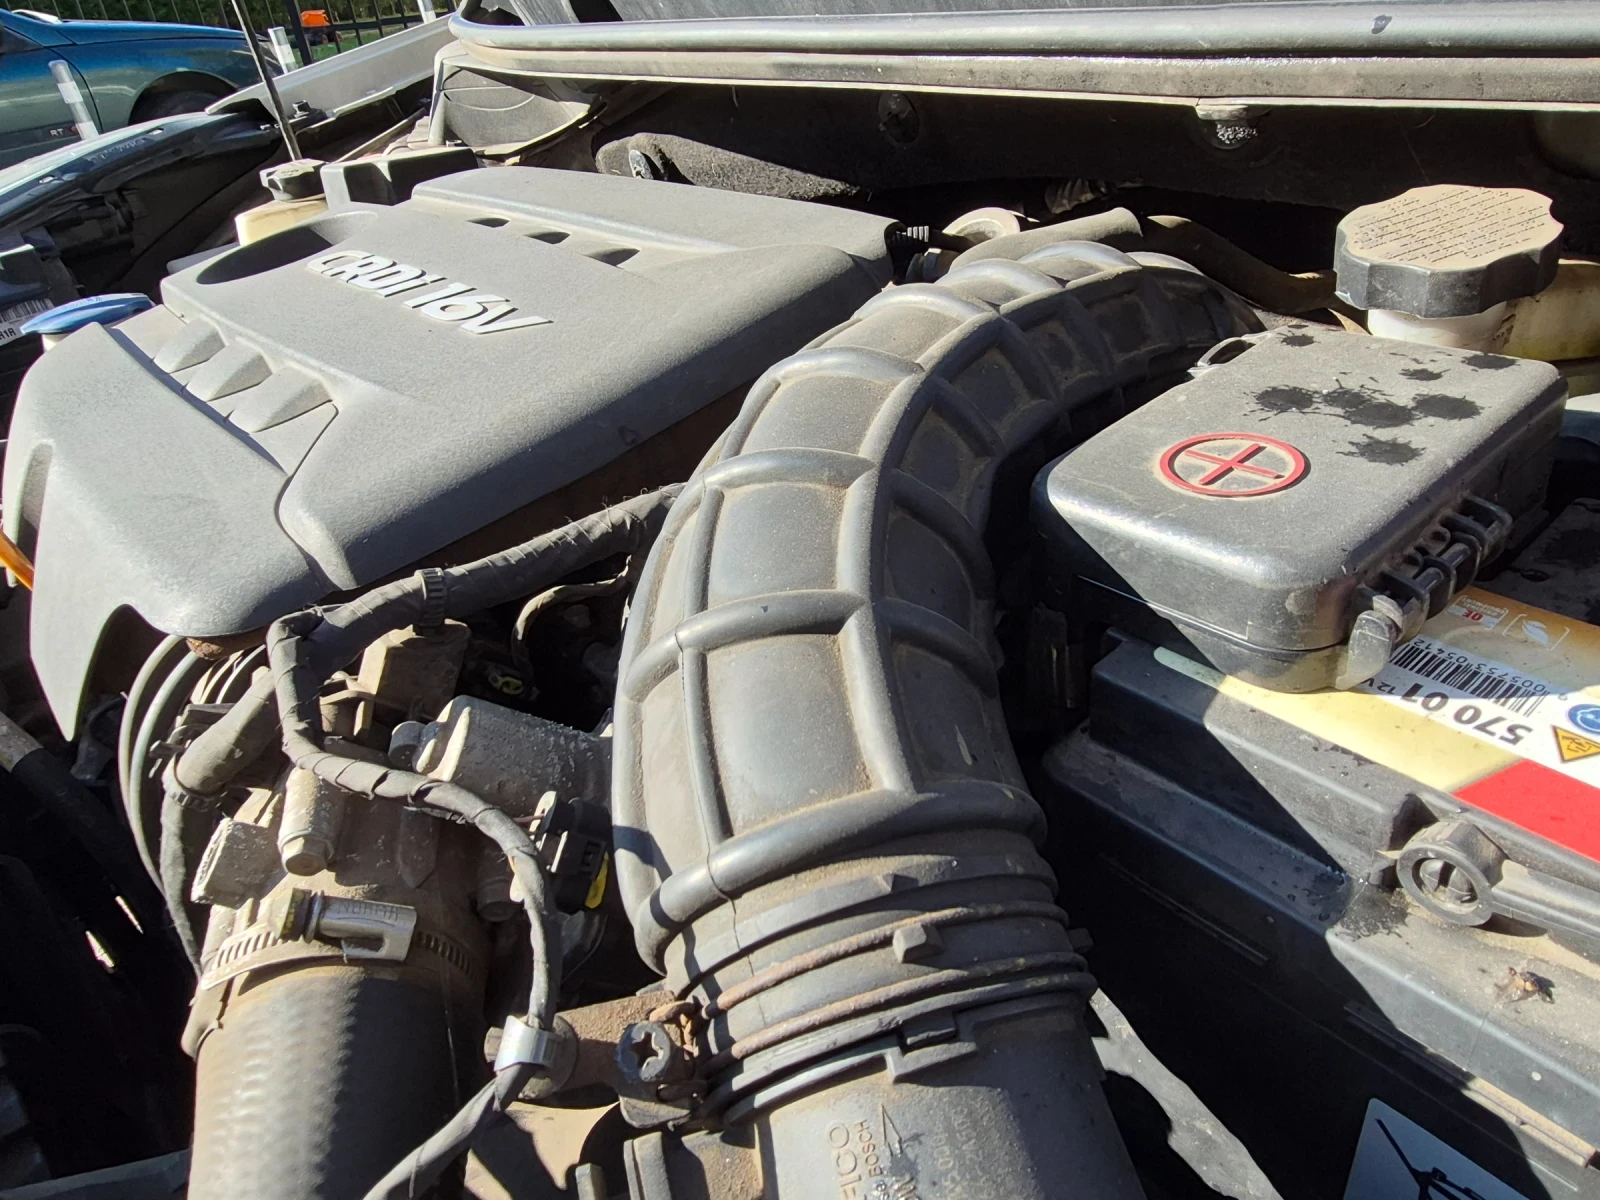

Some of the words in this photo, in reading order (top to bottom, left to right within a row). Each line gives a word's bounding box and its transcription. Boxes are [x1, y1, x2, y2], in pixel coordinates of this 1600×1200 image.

[403, 282, 555, 335] 16V
[1461, 609, 1484, 622] OE
[1474, 662, 1546, 693] 005753
[1401, 682, 1449, 712] 01
[1453, 704, 1533, 746] 570
[855, 1118, 884, 1179] BOSCH
